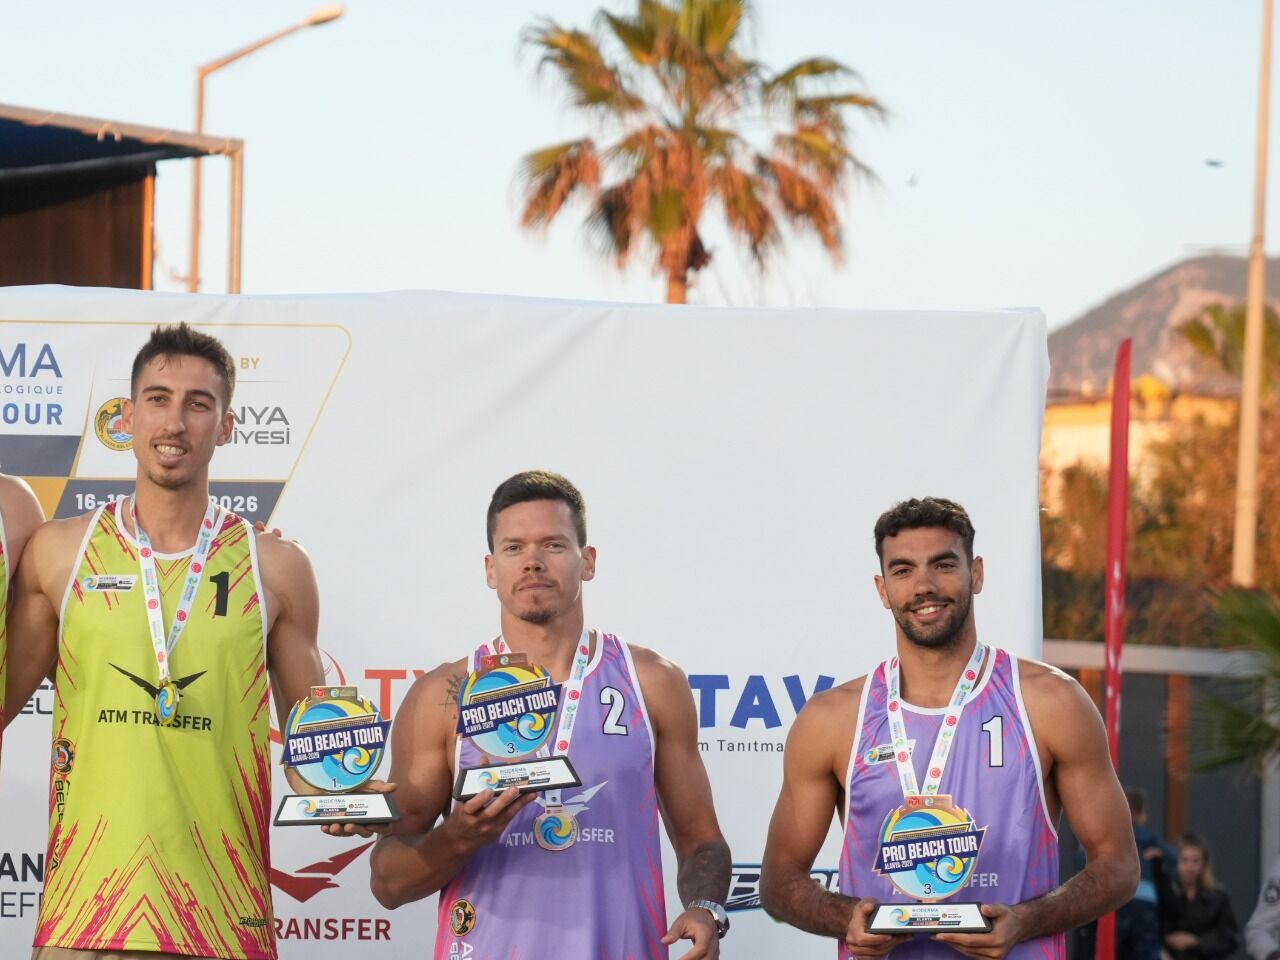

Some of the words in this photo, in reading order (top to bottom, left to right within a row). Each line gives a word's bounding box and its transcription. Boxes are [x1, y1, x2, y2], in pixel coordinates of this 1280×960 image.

[240, 357, 260, 370] BY
[234, 406, 290, 426] NYA
[209, 571, 229, 618] 1
[462, 706, 487, 726] PRO
[487, 698, 526, 721] BEACH
[526, 690, 557, 712] TOUR
[600, 686, 628, 737] 2
[688, 674, 835, 730] TAV
[98, 709, 127, 723] ATM
[132, 710, 212, 731] TRASFER
[289, 737, 312, 755] PRO
[314, 731, 352, 751] BEACH
[353, 726, 384, 744] TOUR
[717, 739, 784, 752] Tanıtma
[981, 715, 1004, 768] 1
[506, 832, 534, 847] ATM
[882, 845, 906, 862] PRO
[908, 840, 946, 860] BEACH
[947, 835, 978, 853] TOUR
[274, 918, 392, 941] RANSFER
